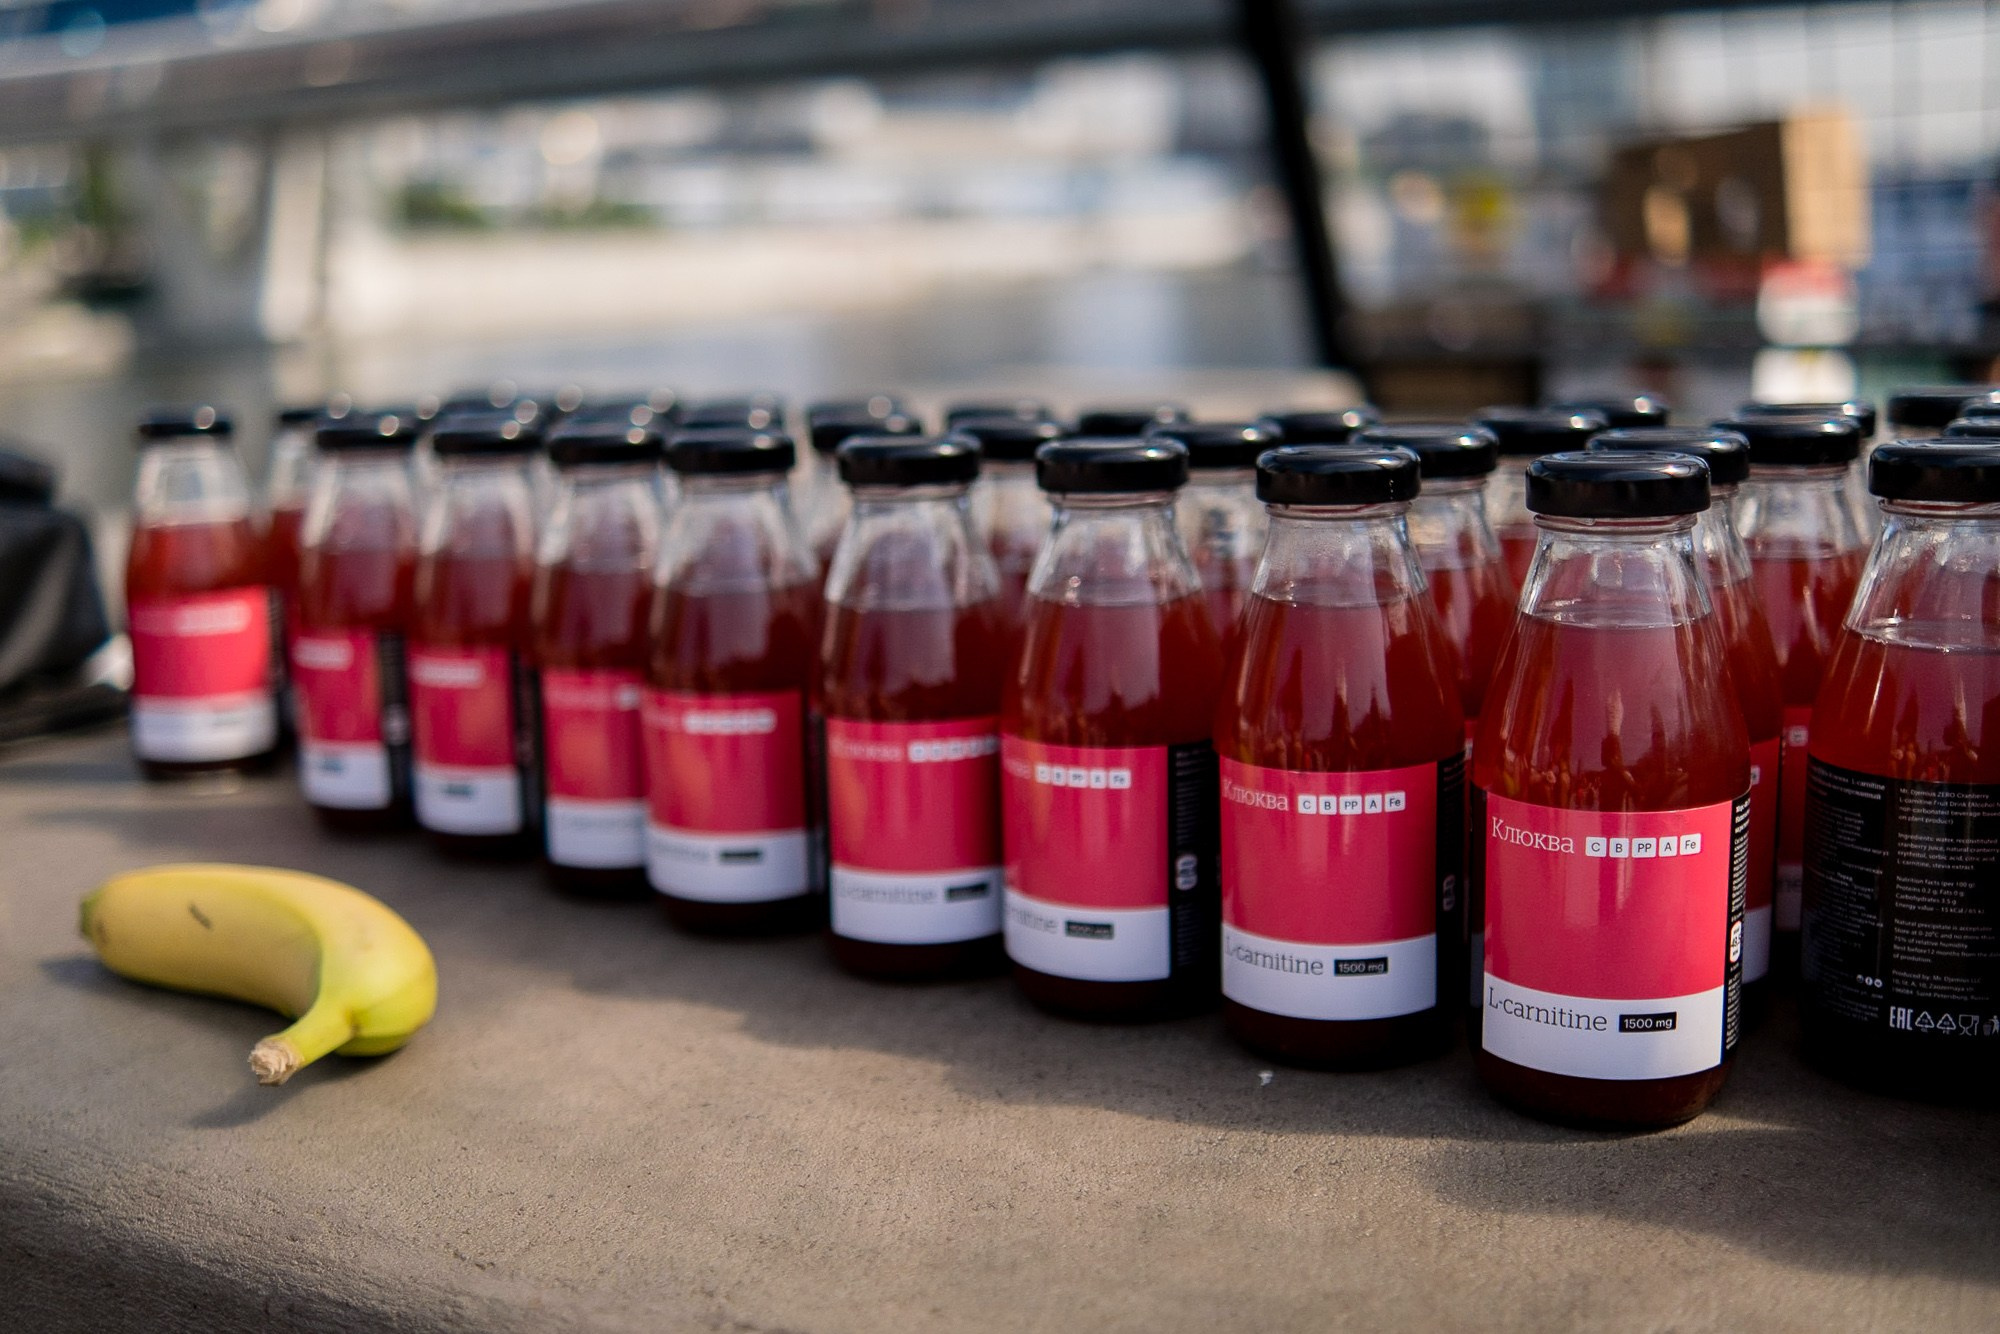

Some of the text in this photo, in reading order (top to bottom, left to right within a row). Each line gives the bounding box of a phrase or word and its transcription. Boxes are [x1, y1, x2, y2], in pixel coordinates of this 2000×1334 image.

[1222, 778, 1289, 811] Клюква
[1344, 800, 1358, 810] PP
[1491, 816, 1575, 854] Клюква
[1637, 843, 1652, 853] PP
[1897, 876, 1924, 884] Nutrition
[1896, 884, 1920, 893] Proteins
[1896, 893, 1940, 903] Carbohydrates
[1895, 902, 1916, 910] Energy
[1918, 904, 1934, 912] value
[1894, 918, 1917, 926] Natural
[1225, 935, 1384, 976] L-carnitine 1500 mg
[1892, 970, 1921, 978] Produced
[1488, 986, 1673, 1032] L-carnitine 1500 mg
